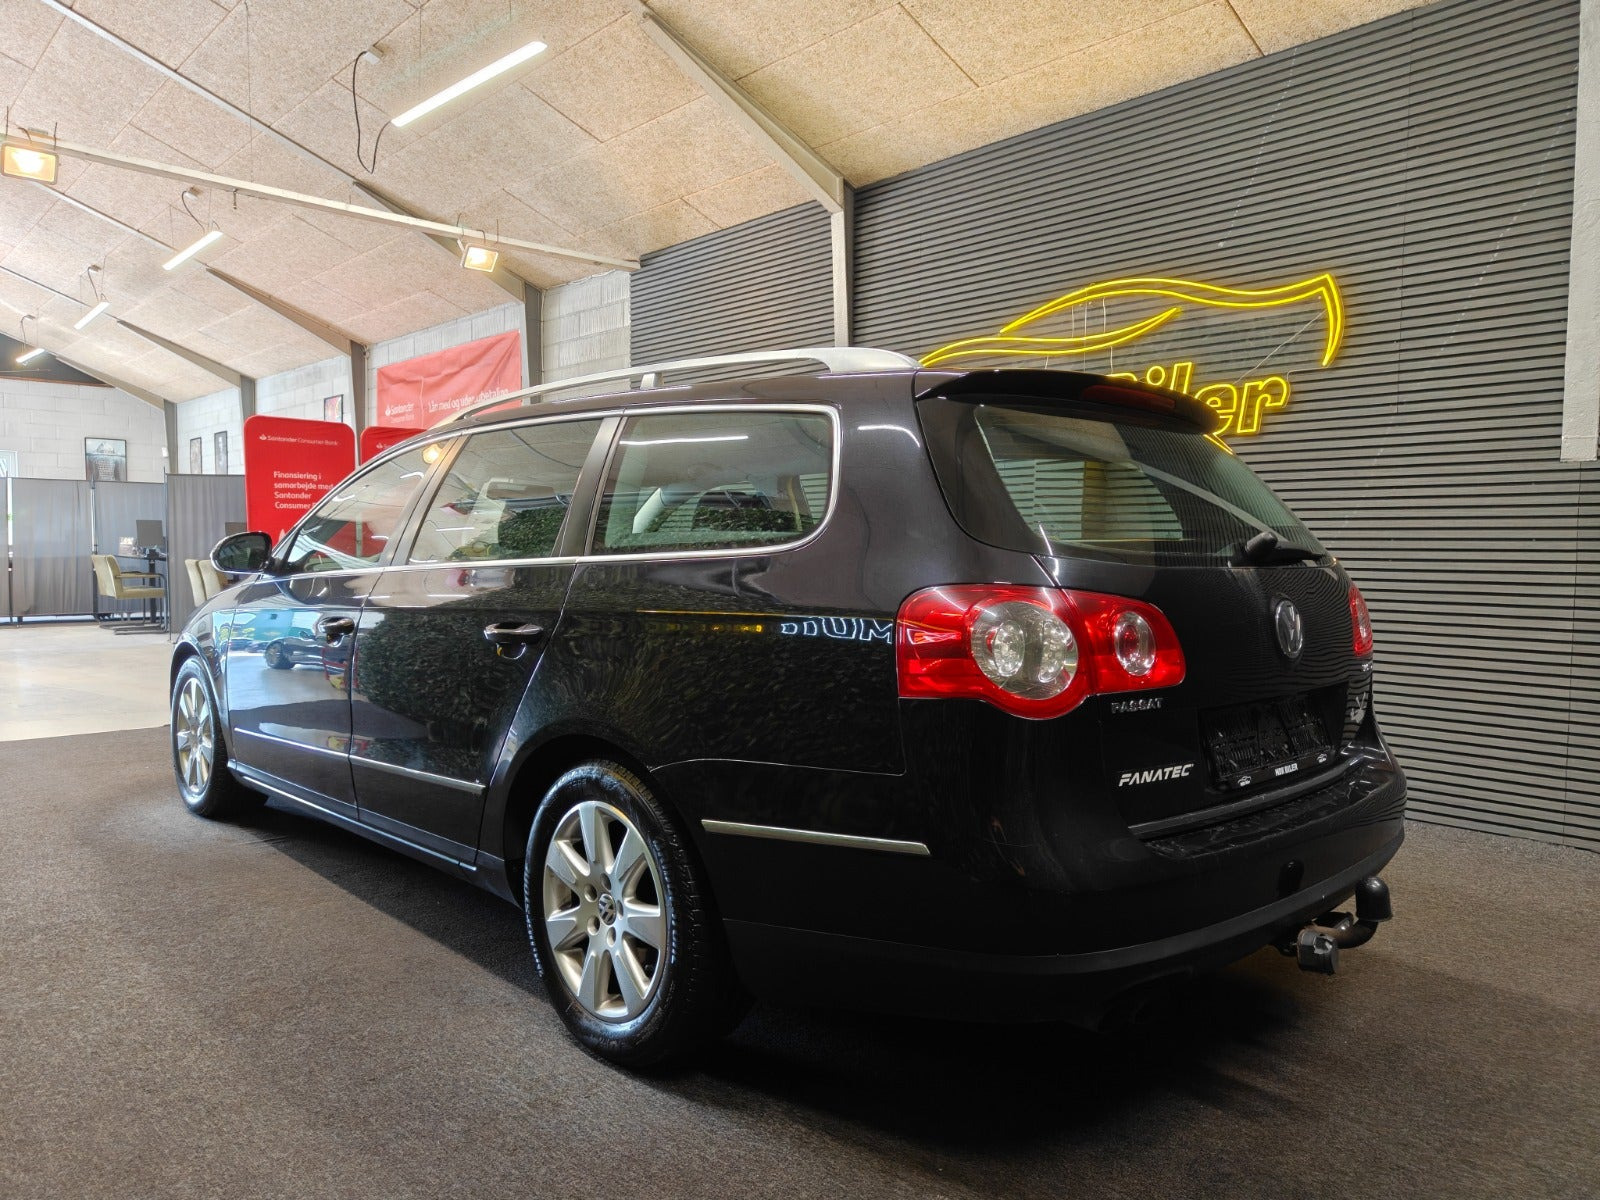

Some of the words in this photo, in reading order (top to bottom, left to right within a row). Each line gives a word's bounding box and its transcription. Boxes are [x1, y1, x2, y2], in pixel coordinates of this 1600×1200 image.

[273, 470, 318, 482] Finansiering
[273, 482, 317, 491] samarbejde
[274, 491, 312, 499] Santander
[274, 501, 311, 509] Consumer
[1111, 697, 1163, 714] PASSAT
[1118, 763, 1194, 787] FANATEC
